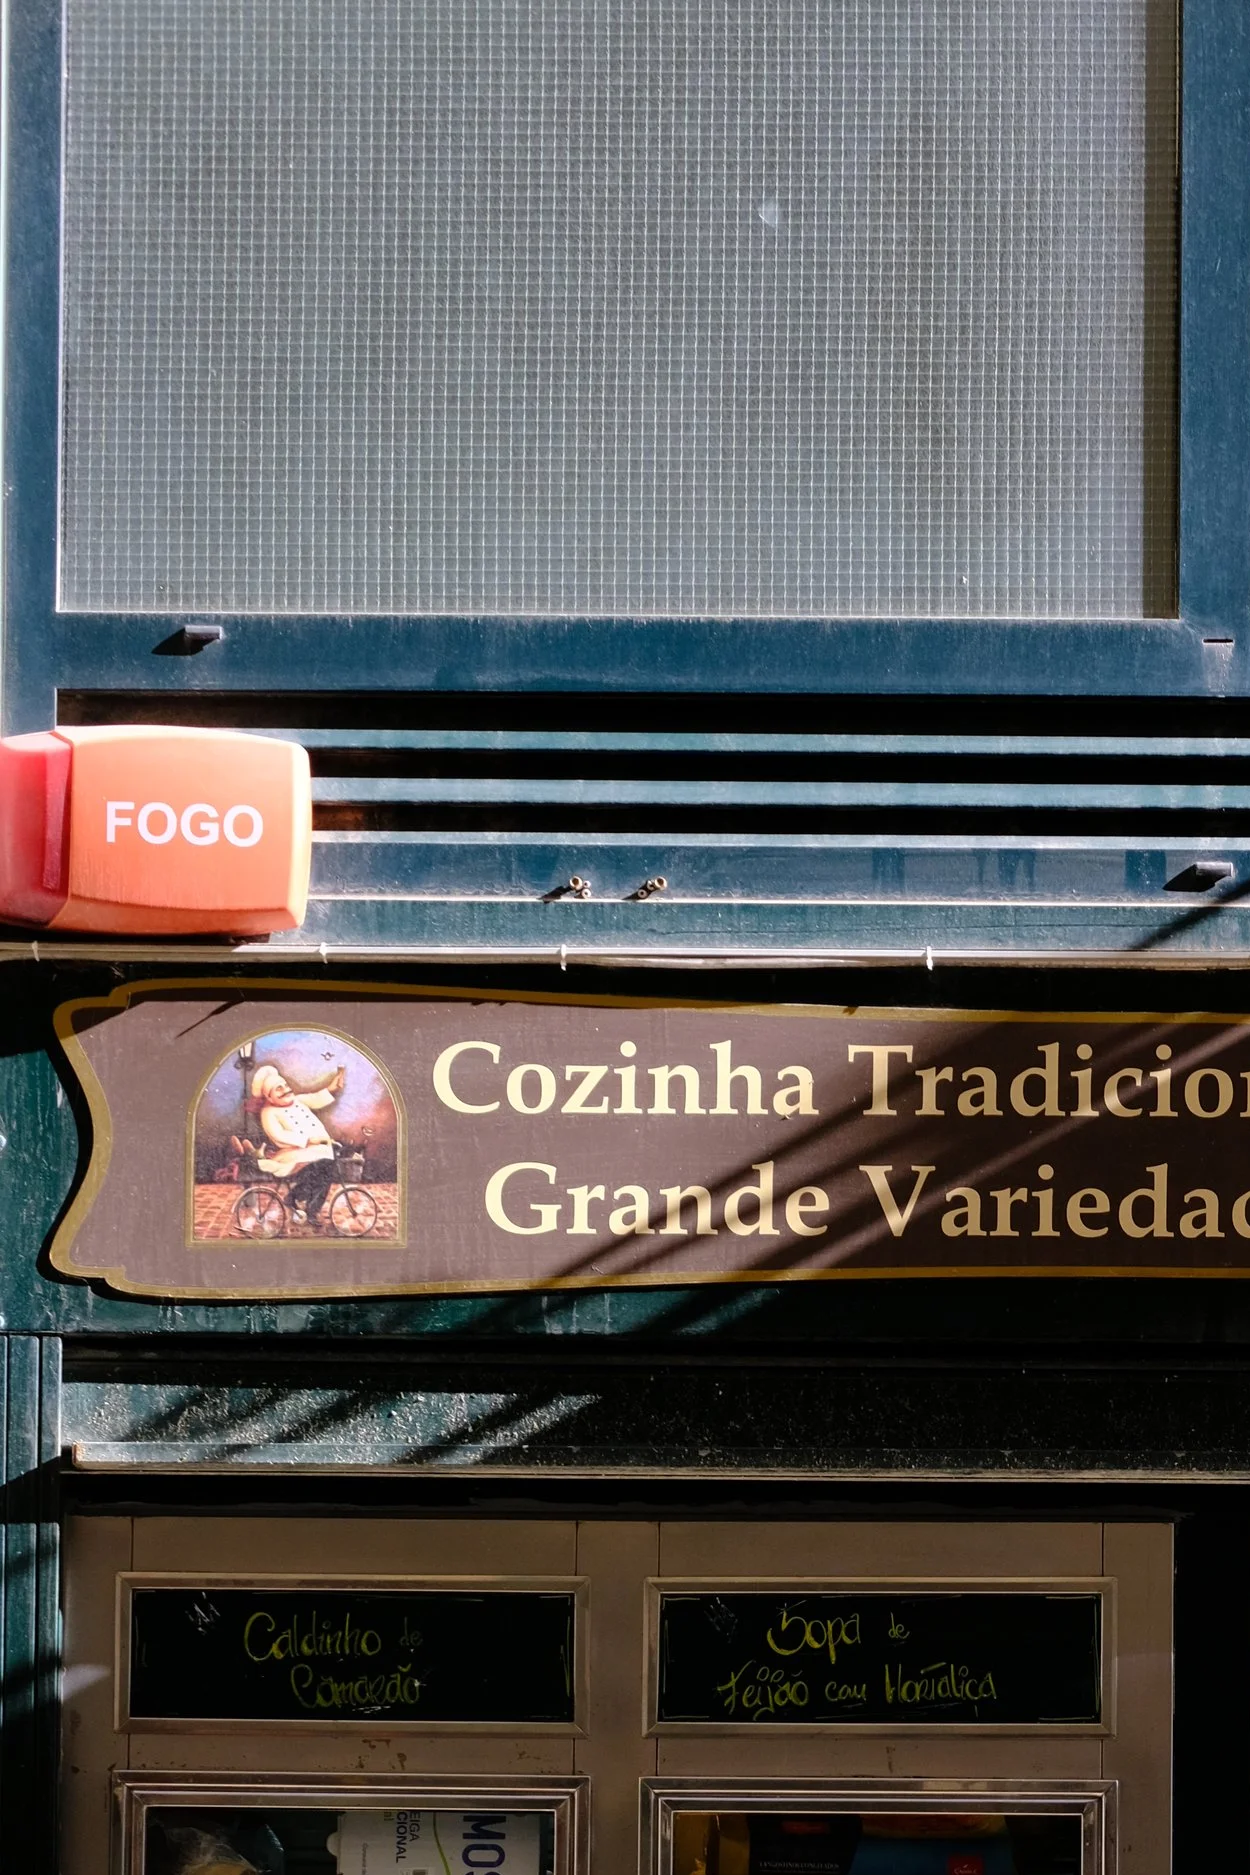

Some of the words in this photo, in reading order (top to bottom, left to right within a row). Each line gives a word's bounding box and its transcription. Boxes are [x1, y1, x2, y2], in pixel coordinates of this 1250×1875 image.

[106, 800, 264, 848] FOGO
[432, 1040, 819, 1117] Cozinha
[484, 1162, 829, 1237] Grande
[244, 1610, 383, 1661] Caldinho
[399, 1616, 423, 1647] de
[766, 1599, 861, 1664] Sopa
[888, 1612, 911, 1639] de
